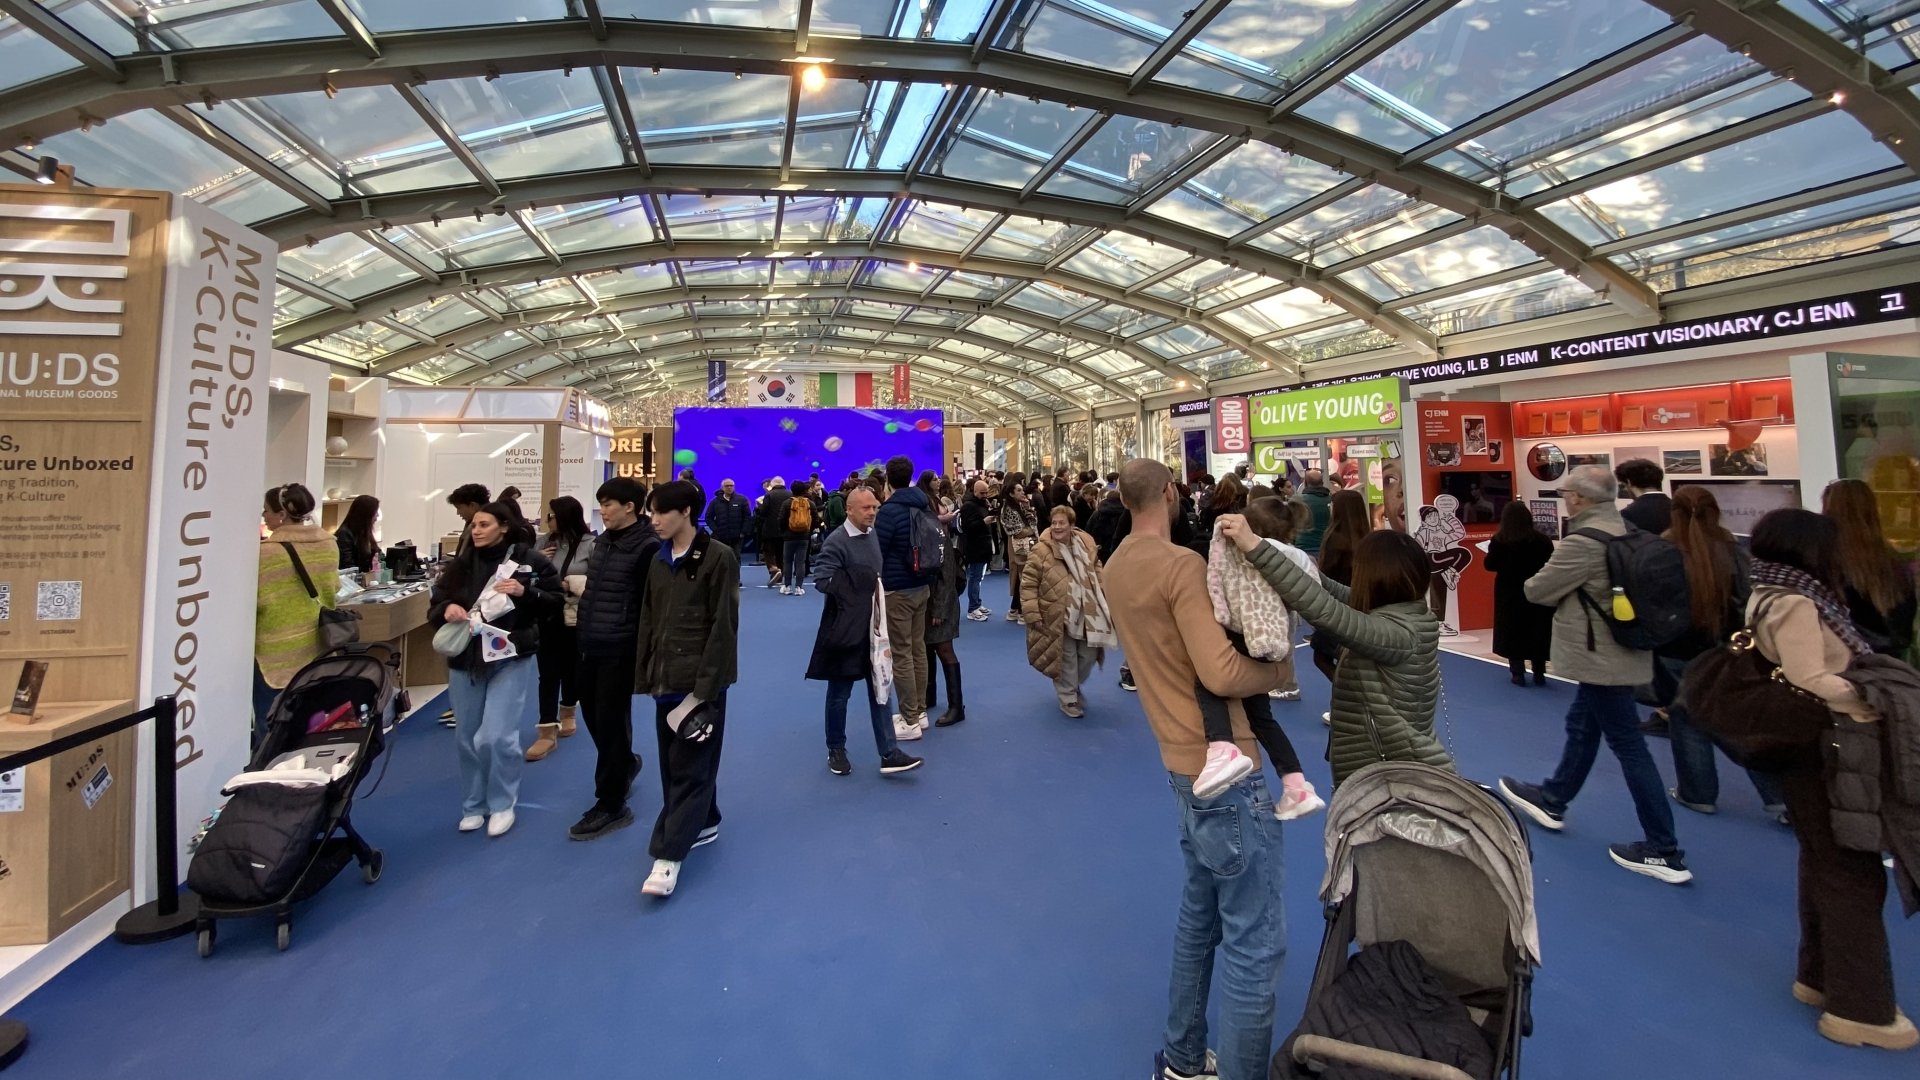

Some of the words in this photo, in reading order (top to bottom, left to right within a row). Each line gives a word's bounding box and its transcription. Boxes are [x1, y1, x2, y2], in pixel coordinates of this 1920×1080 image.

[222, 243, 263, 429] MU:DS,
[1507, 350, 1538, 366] ENM
[1551, 332, 1649, 360] K-CONTENT
[1652, 314, 1770, 344] VISIONARY,
[1773, 309, 1805, 328] CJ
[183, 227, 231, 491] K-Culture
[0, 352, 120, 386] U:DS
[25, 389, 74, 398] MUSEUM
[78, 390, 118, 399] GOODS
[1179, 401, 1203, 412] DISCOVER
[1260, 402, 1308, 425] OLIVE
[1313, 393, 1384, 420] YOUNG
[505, 448, 538, 457] MU:DS,
[43, 455, 134, 471] Unboxed
[19, 477, 80, 489] Tradition,
[7, 490, 66, 502] K-Culture
[1532, 515, 1558, 523] SEOUL
[173, 510, 211, 771] Unboxed
